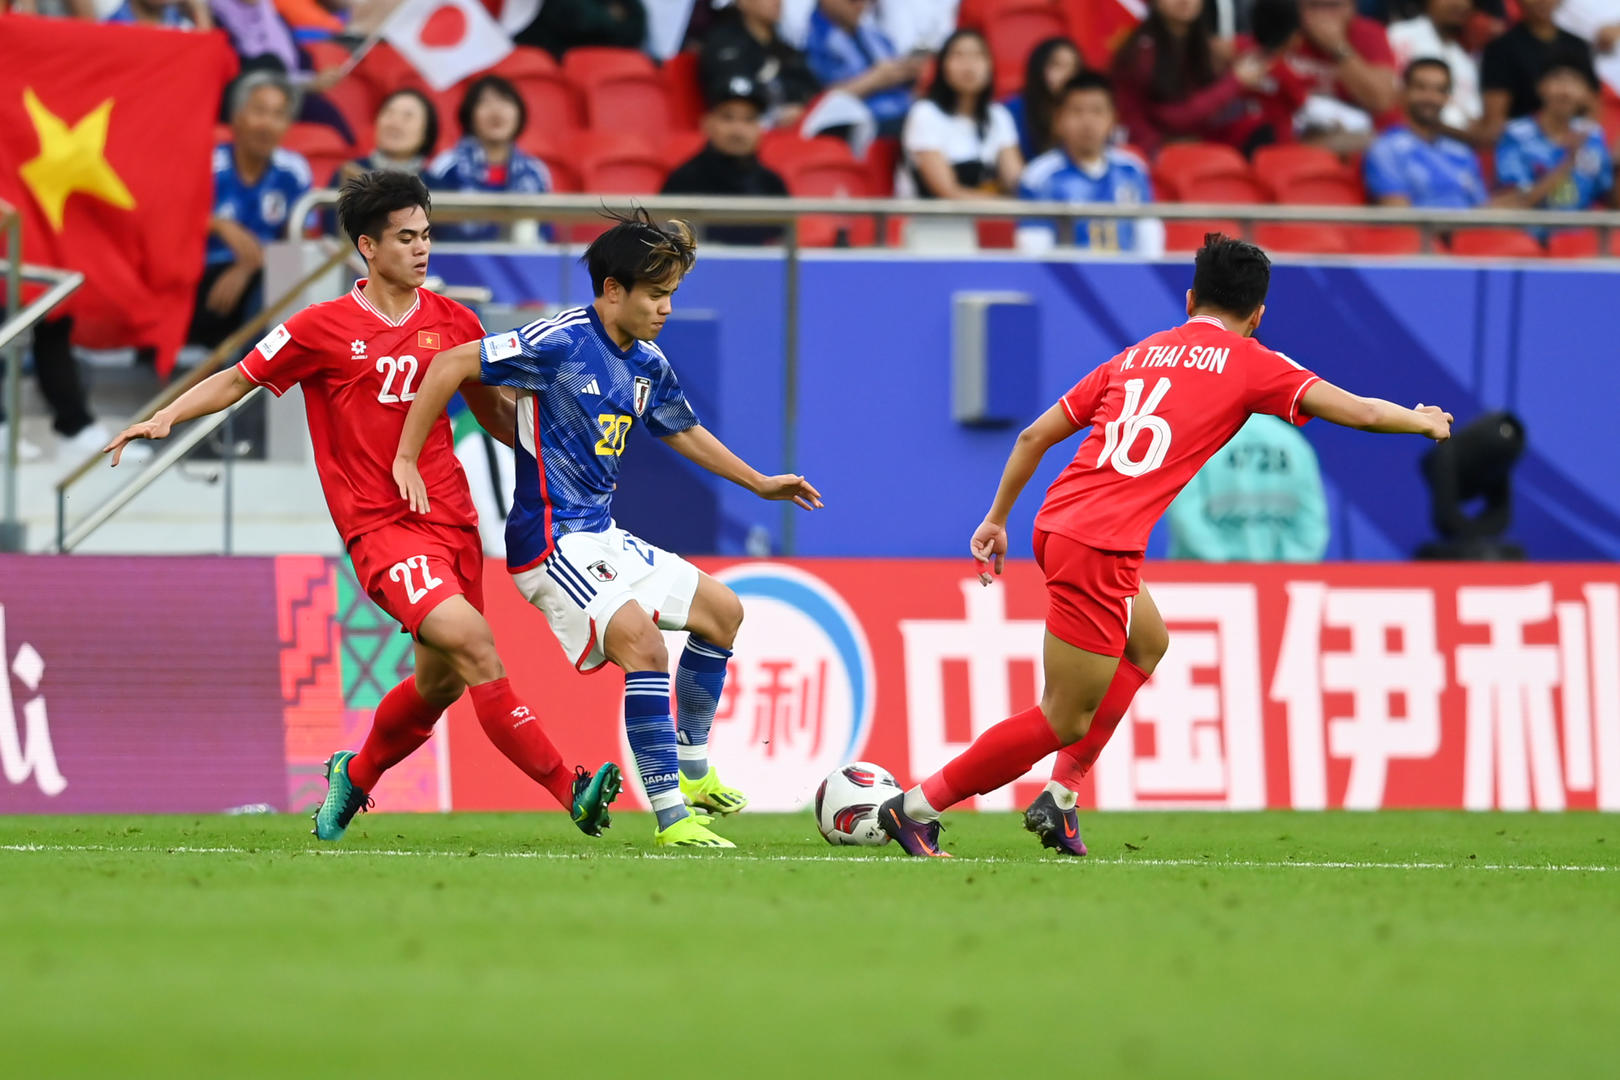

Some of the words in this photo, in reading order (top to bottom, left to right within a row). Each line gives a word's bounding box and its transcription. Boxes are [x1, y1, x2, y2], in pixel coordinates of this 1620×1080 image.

[376, 355, 418, 404] 22
[1120, 348, 1140, 372] N.
[1140, 345, 1187, 368] THAI
[1183, 345, 1230, 374] SON
[595, 413, 632, 457] 20
[1096, 377, 1172, 478] 16
[389, 555, 444, 605] 22
[643, 772, 679, 785] JAPAN
